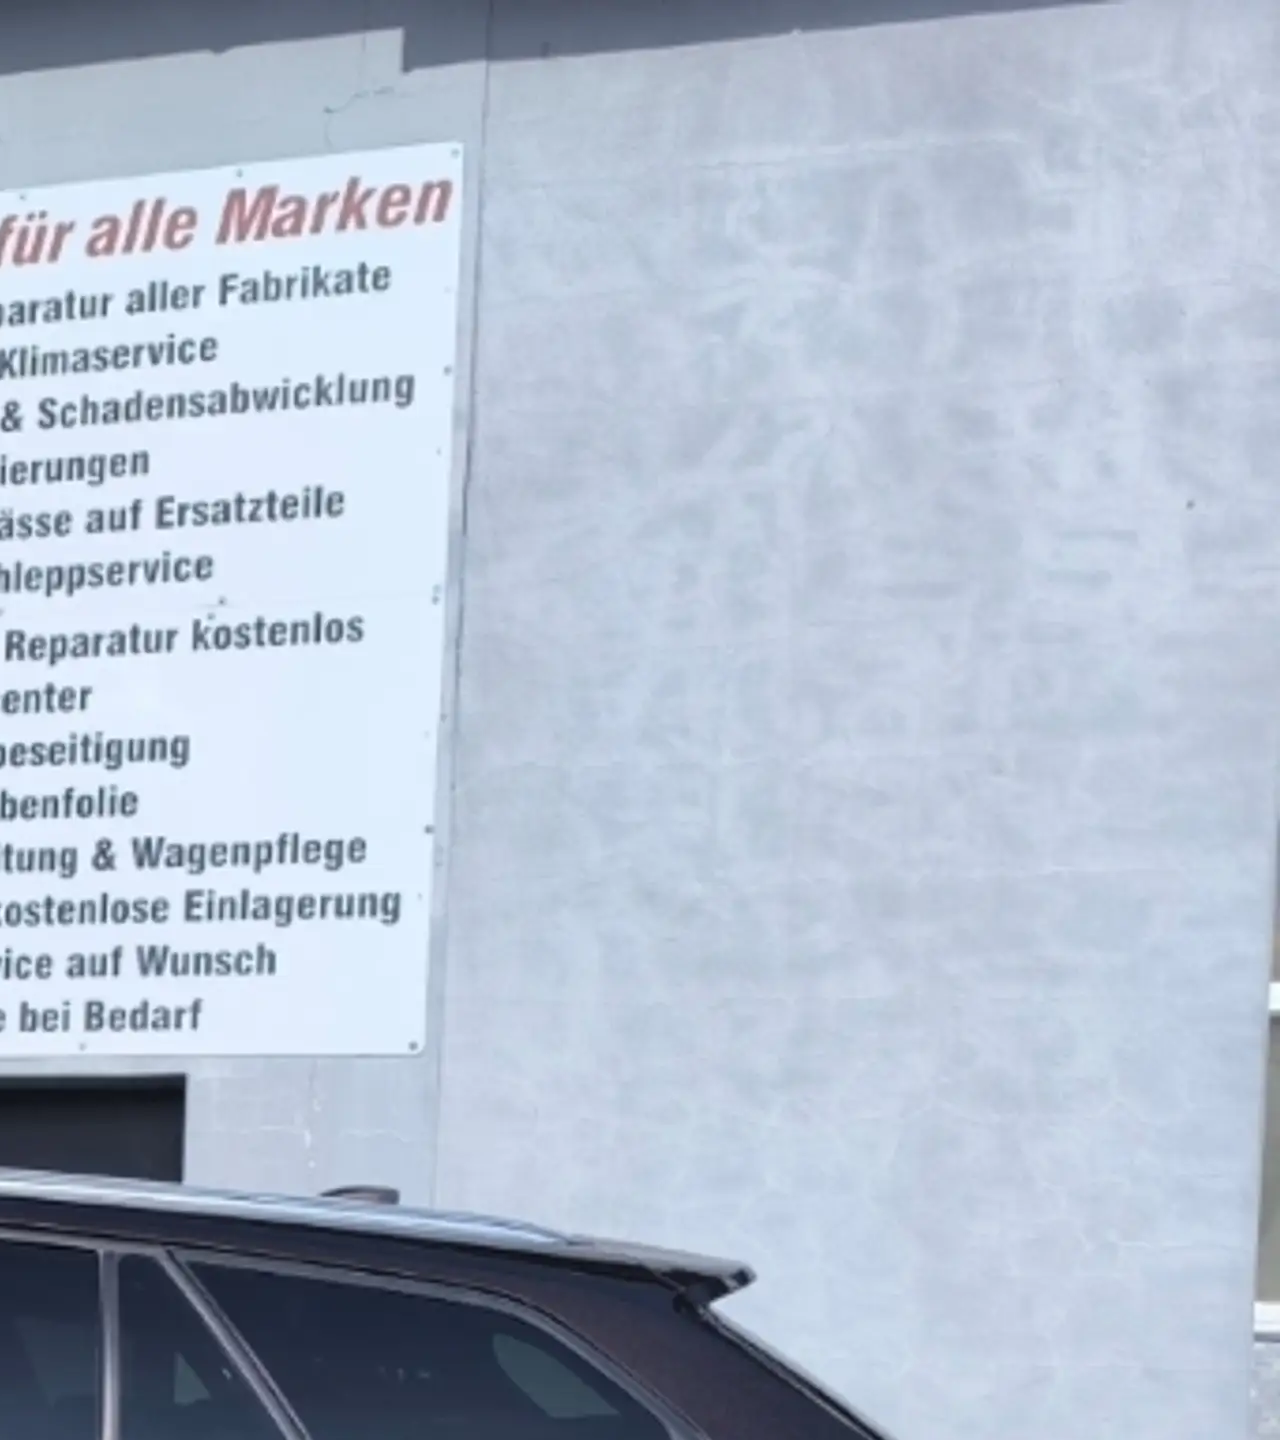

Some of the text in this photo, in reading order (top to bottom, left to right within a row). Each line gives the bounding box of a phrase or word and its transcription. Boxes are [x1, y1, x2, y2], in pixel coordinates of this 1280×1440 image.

[85, 197, 198, 258] alle
[215, 176, 453, 245] Marken
[124, 279, 207, 317] aller
[218, 261, 392, 307] Fabrikate
[0, 399, 24, 434] &
[37, 372, 416, 431] Schadensabwicklung
[84, 498, 143, 535] auf
[154, 484, 345, 530] Ersatzteile
[4, 623, 179, 668] Reparatur
[191, 610, 365, 652] kostenlos
[90, 836, 117, 872] &
[131, 831, 367, 876] Wagenpflege
[183, 888, 402, 928] Einlagerung
[65, 944, 124, 980] auf
[135, 942, 277, 978] Wunsch
[18, 999, 72, 1033] bei
[83, 997, 203, 1033] Bedarf
